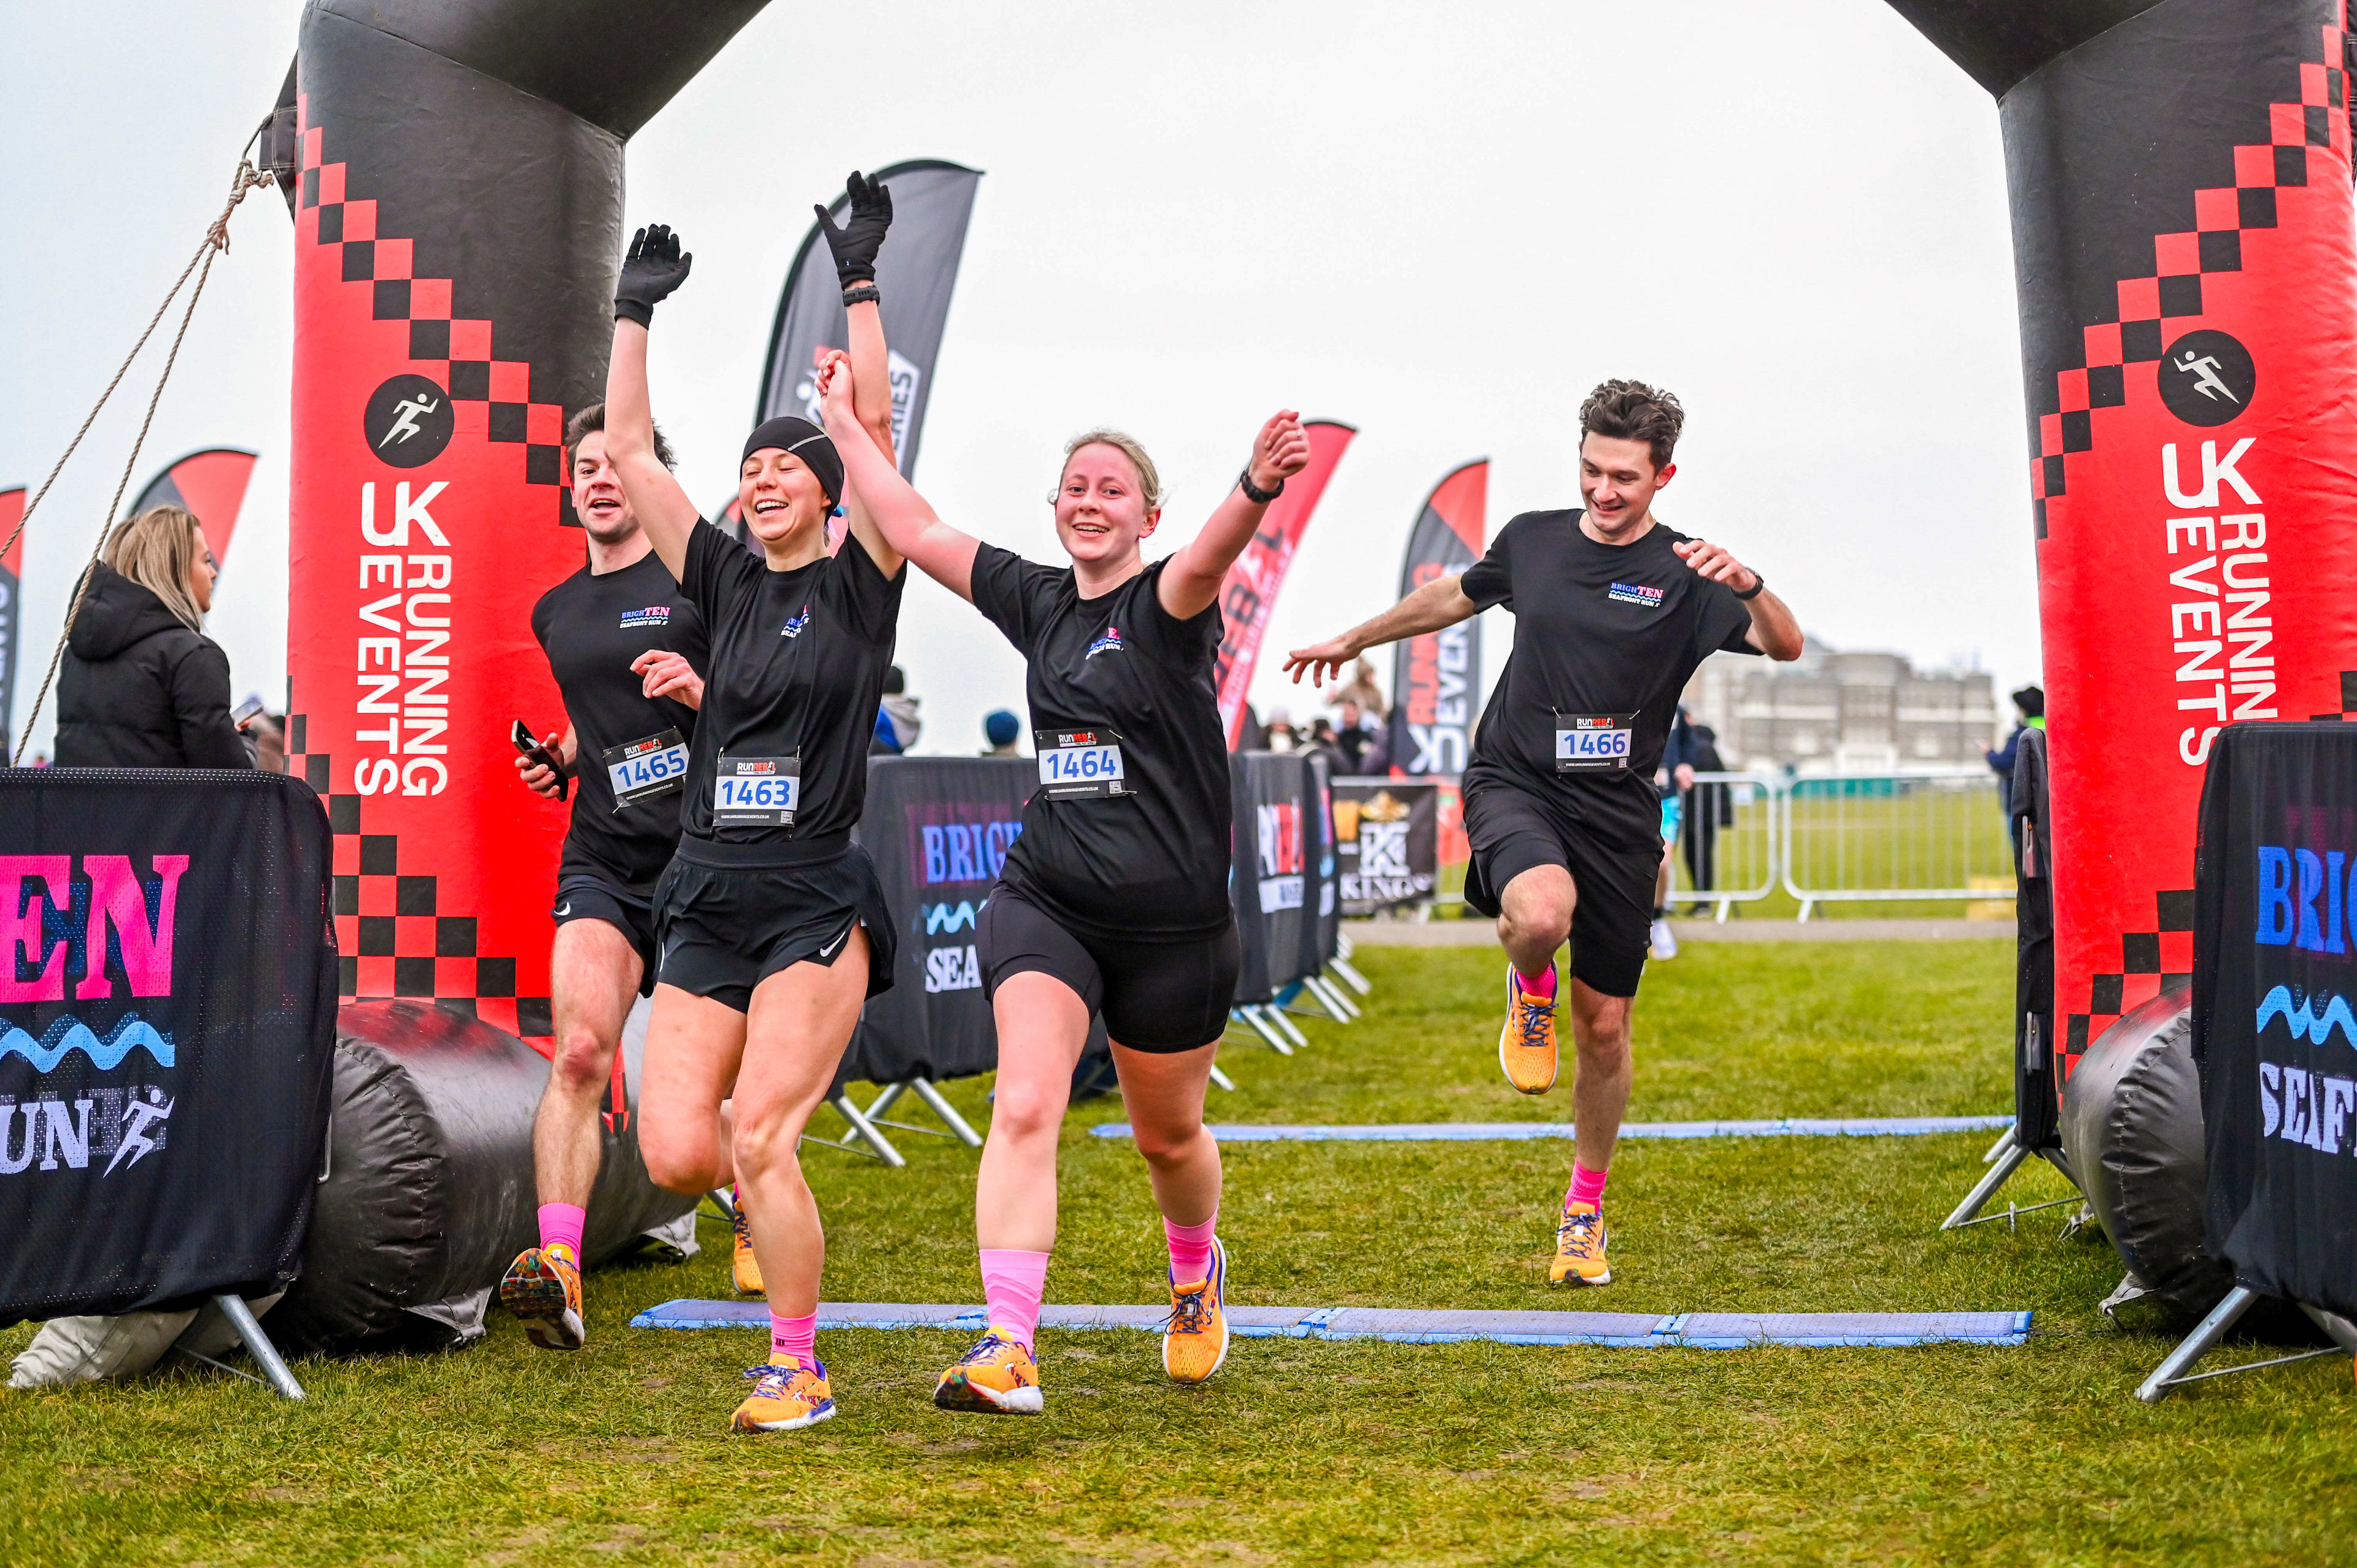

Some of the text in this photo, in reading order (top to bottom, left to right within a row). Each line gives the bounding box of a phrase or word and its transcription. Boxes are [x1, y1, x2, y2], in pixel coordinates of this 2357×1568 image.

[2161, 438, 2264, 509] UK
[361, 481, 451, 547] UK
[1608, 593, 1641, 604] SEAFRONT
[2220, 513, 2278, 720] RUNNIN
[2166, 516, 2229, 767] EVENTS
[354, 555, 402, 796] EVENTS
[401, 555, 451, 797] RUNNING
[617, 749, 685, 787] 1465
[1047, 751, 1116, 779] 1464
[1564, 733, 1625, 755] 1466
[722, 780, 790, 806] 1463
[923, 821, 1023, 883] BRIG
[2259, 1062, 2357, 1159] SEAF
